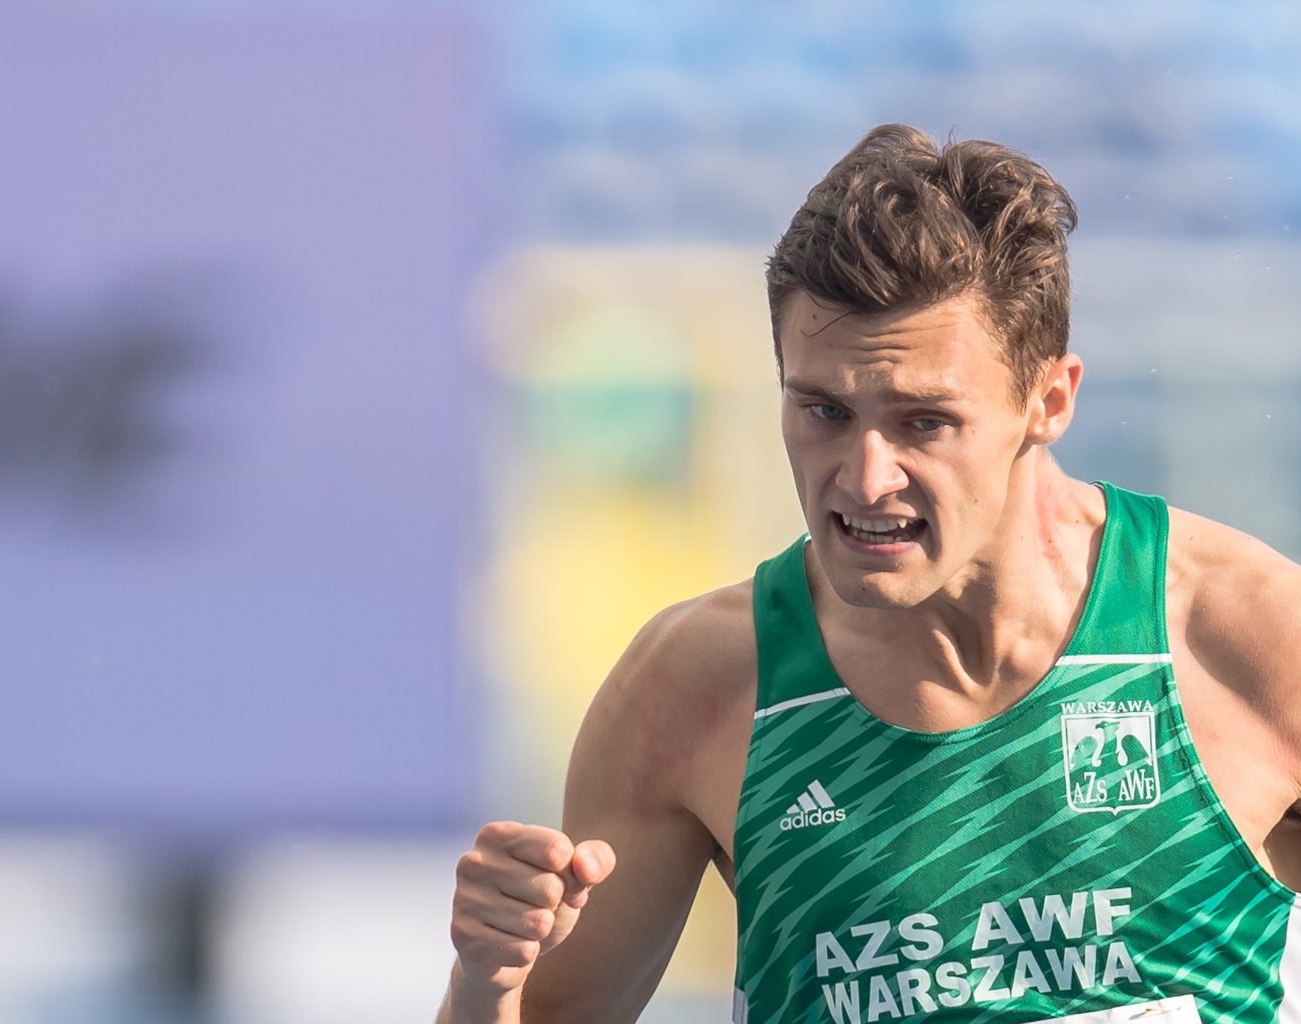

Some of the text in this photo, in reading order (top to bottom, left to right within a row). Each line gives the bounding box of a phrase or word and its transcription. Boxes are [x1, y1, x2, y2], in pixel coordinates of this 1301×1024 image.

[1060, 700, 1154, 714] WARSZAWA
[1073, 769, 1155, 804] AZS AWF
[780, 808, 846, 831] adidas
[815, 887, 1133, 978] AZS AWF
